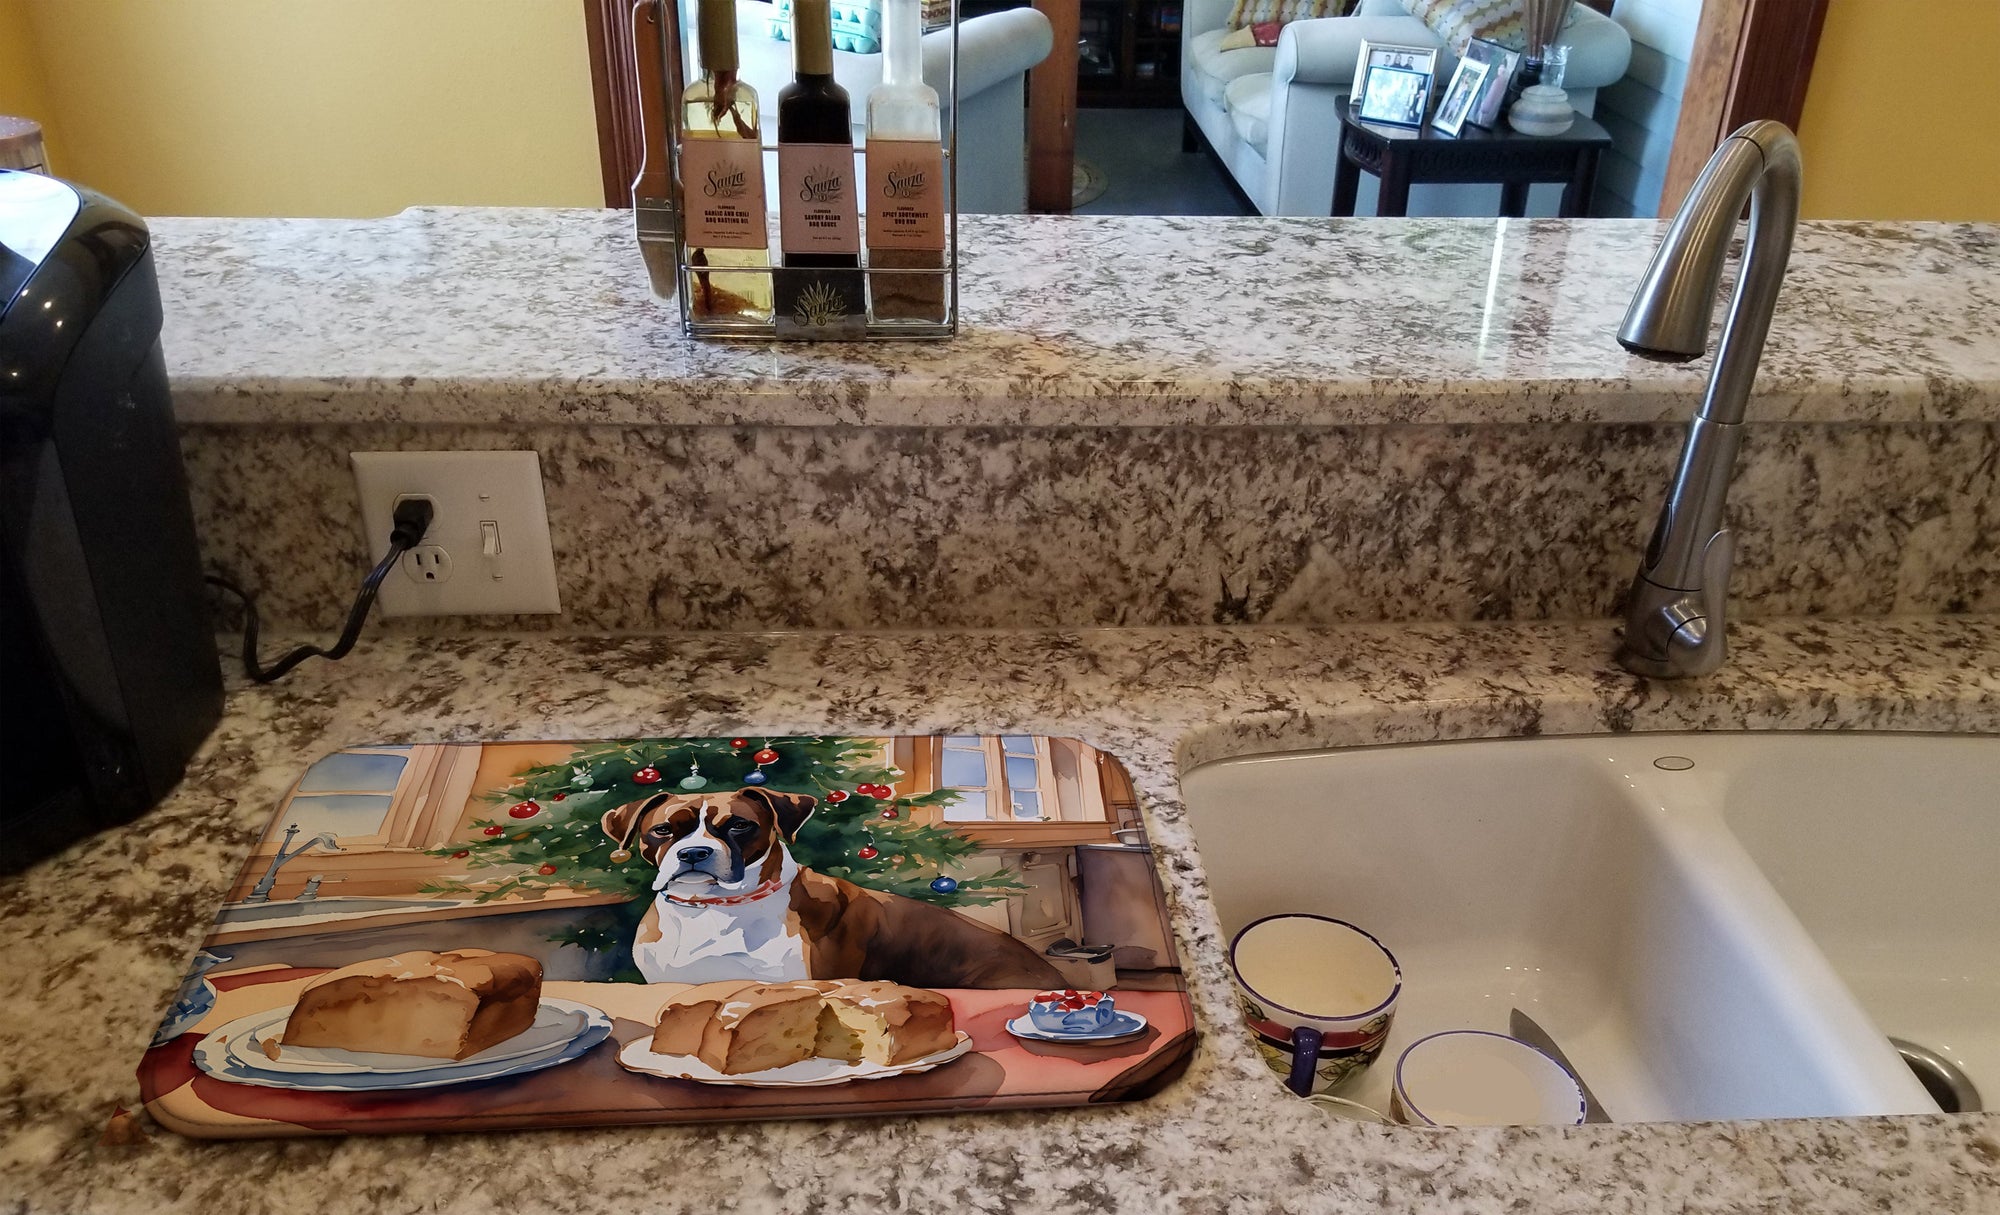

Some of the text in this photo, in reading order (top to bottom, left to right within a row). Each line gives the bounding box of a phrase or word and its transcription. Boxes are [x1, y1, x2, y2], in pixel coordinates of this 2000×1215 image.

[704, 170, 745, 197] Sauza
[800, 175, 842, 202] Sauza
[884, 171, 924, 198] Sauza
